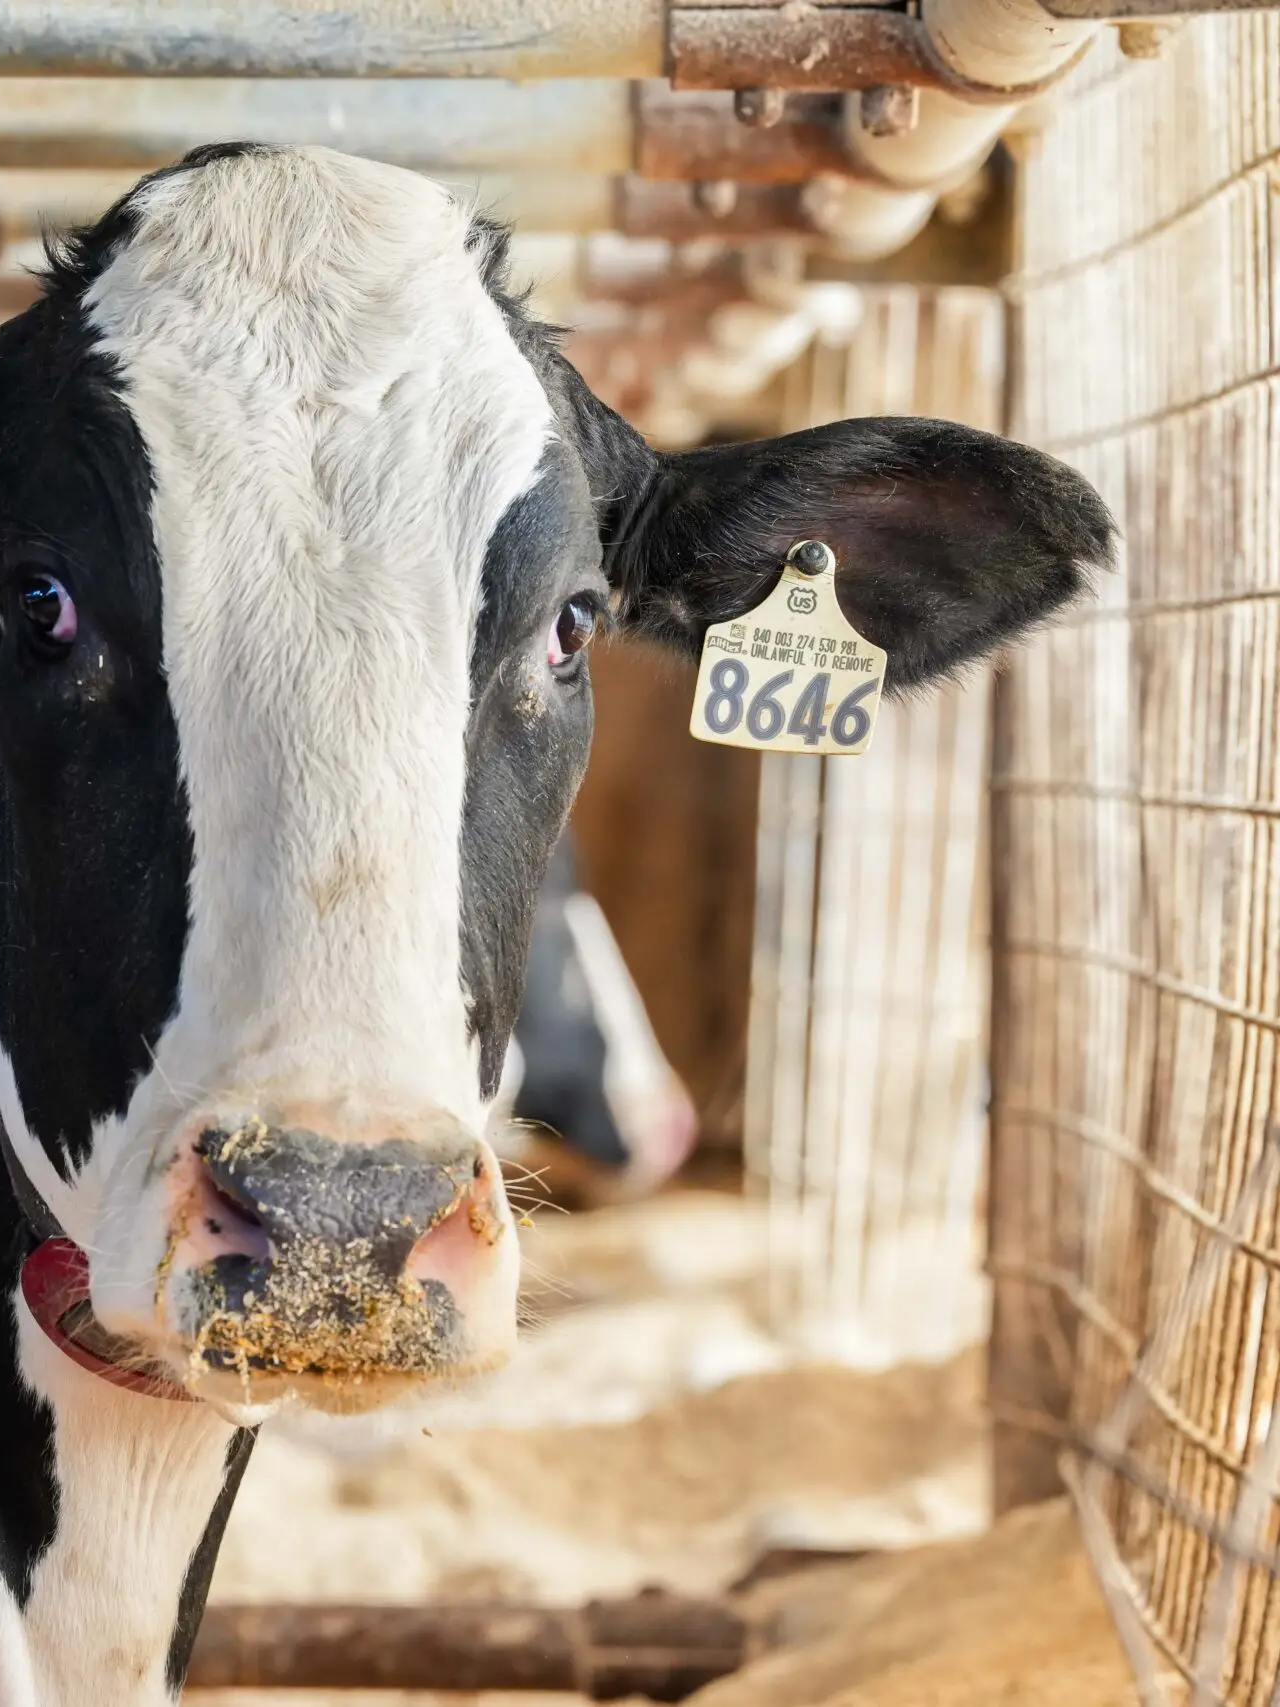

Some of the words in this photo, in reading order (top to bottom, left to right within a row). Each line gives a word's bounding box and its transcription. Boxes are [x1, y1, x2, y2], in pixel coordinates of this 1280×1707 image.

[793, 595, 812, 609] US
[753, 627, 772, 644] 840
[775, 632, 792, 647] 003
[797, 635, 815, 651] 274
[818, 637, 836, 654] 530
[840, 641, 858, 657] 981
[750, 643, 806, 666] UNLAWFUL
[814, 652, 827, 668] TO
[831, 655, 874, 673] REMOVE
[704, 658, 880, 746] 8646
